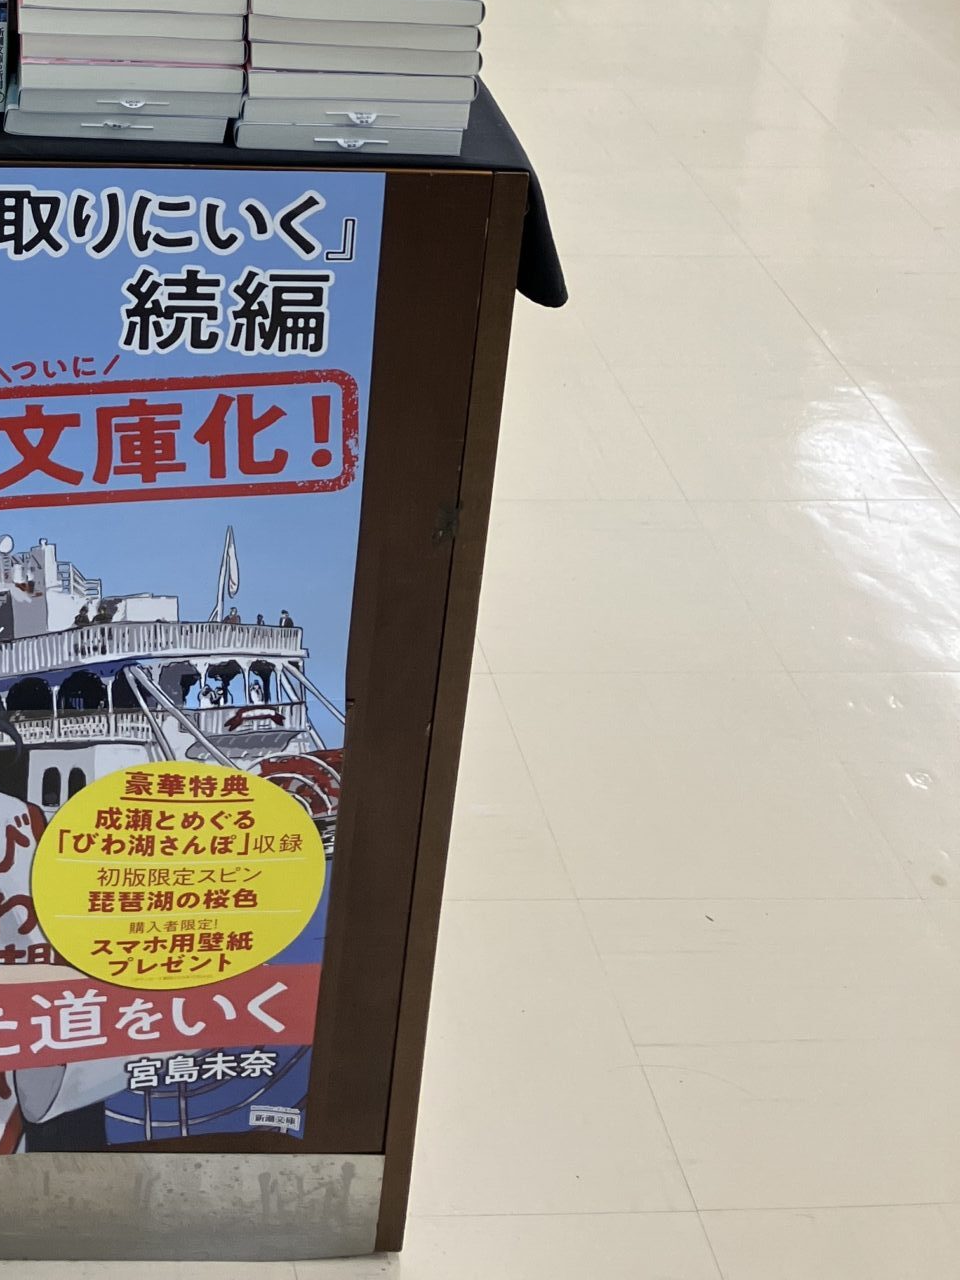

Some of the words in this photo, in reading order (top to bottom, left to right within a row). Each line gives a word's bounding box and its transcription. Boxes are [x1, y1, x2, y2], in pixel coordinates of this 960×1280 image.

[120, 267, 333, 355] 続編
[9, 357, 97, 381] ついに
[125, 771, 250, 798] 豪華特典
[95, 808, 256, 832] 成瀬とめぐる
[58, 831, 304, 858] 「びわ湖さんぽ」収録
[97, 867, 263, 888] 初版限定スピン
[88, 888, 259, 914] 琵琶湖の桜色
[129, 918, 219, 935] 購入者限定!
[90, 931, 255, 957] スマホ用壁紙
[108, 955, 233, 977] プレゼント
[127, 1050, 278, 1090] 宮島未奈
[254, 1114, 297, 1126] 新潮文庫
